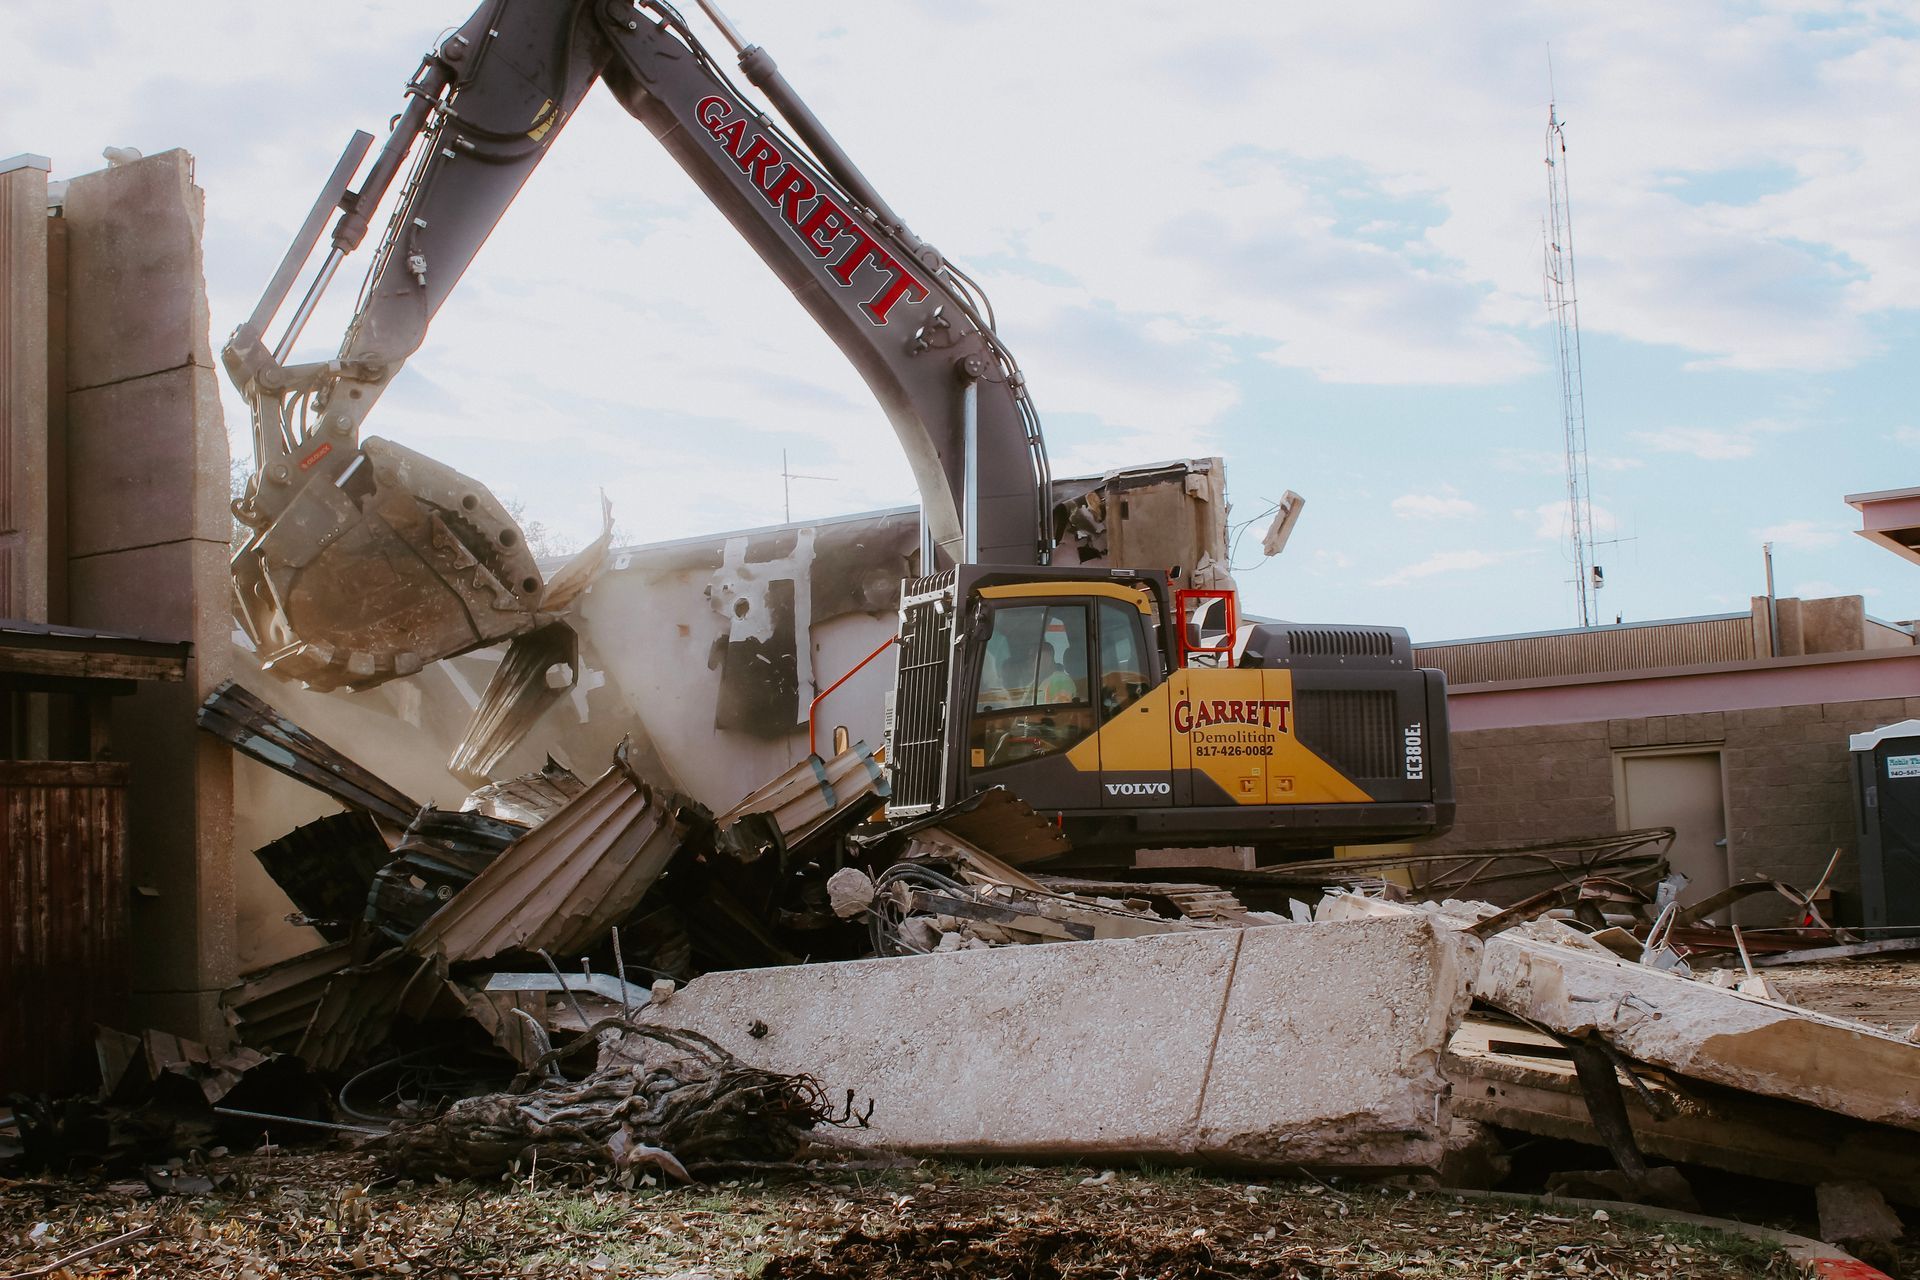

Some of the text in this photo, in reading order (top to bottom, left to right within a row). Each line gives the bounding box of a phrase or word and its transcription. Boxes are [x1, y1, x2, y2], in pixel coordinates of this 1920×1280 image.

[695, 95, 930, 326] GARRETT
[1174, 699, 1291, 734] GARRETT
[1193, 731, 1276, 743] Demolition
[1196, 746, 1274, 756] 817-426-0082
[1105, 783, 1171, 796] VOLVO
